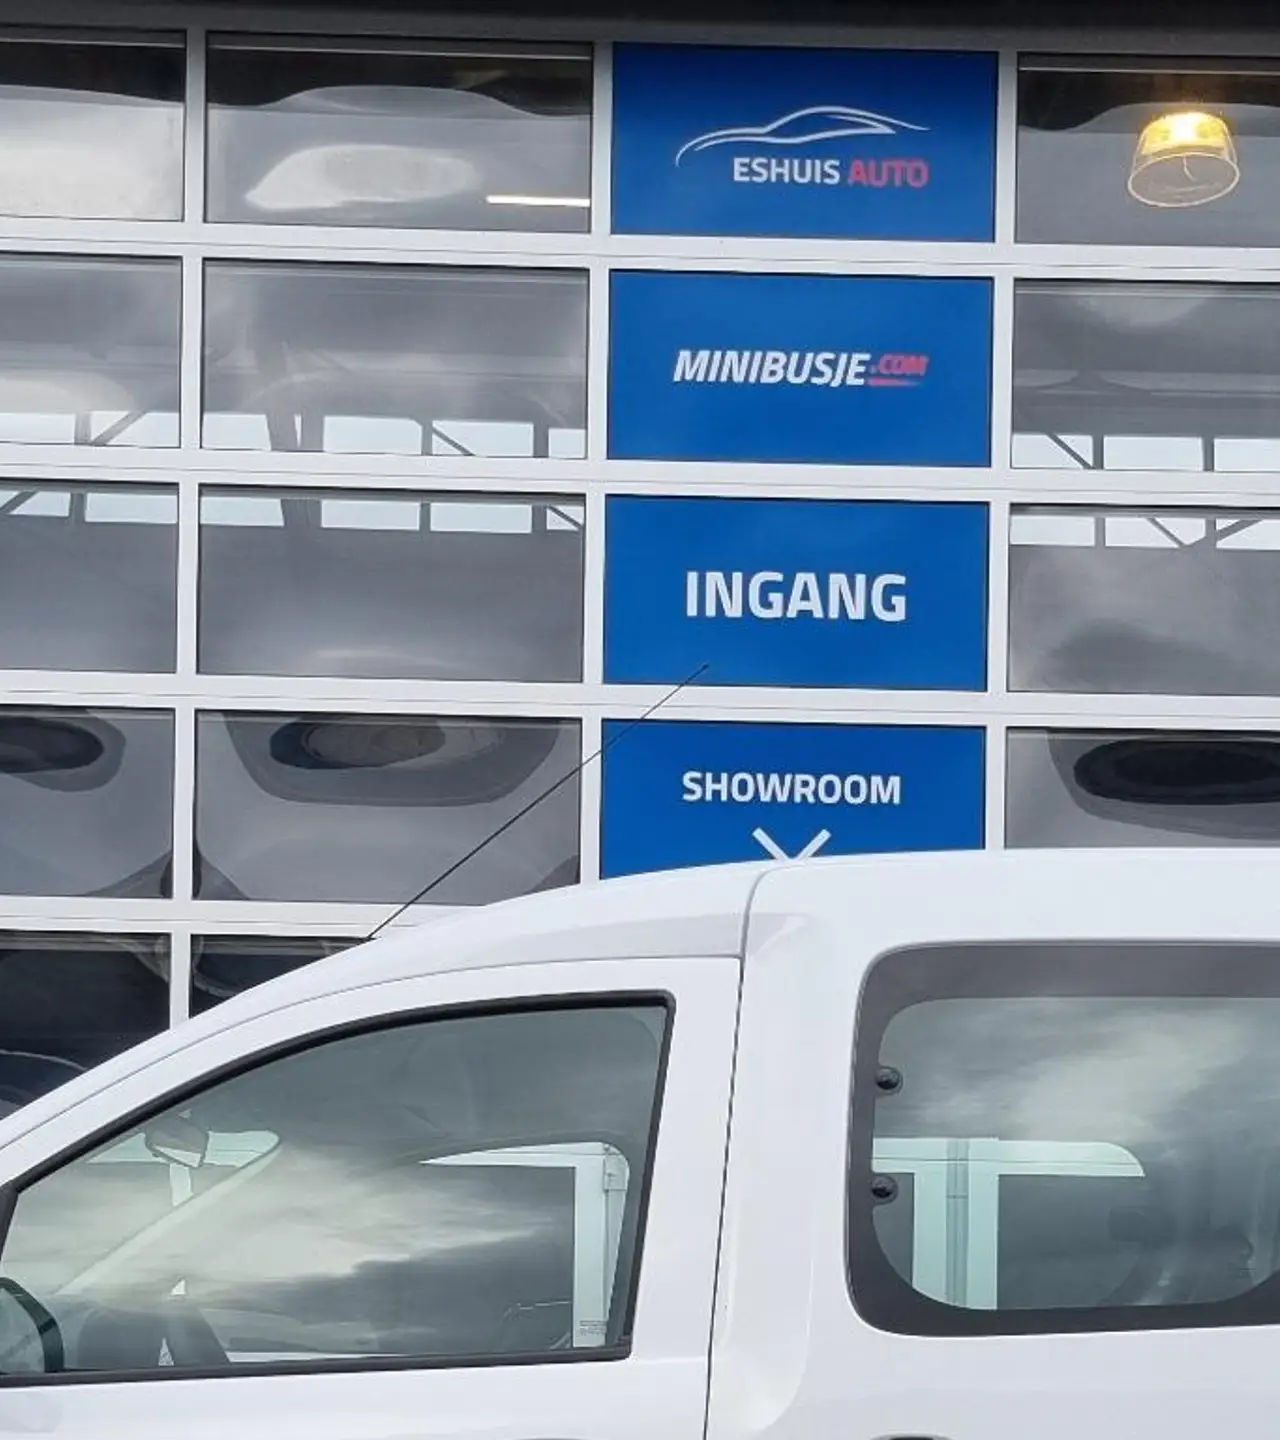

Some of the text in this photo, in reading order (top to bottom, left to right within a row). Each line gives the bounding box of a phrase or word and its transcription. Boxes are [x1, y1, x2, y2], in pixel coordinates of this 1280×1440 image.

[732, 156, 929, 189] ESHUIS AUTO
[673, 348, 929, 388] MINIBUSJE.COM
[685, 570, 908, 623] INGANG
[680, 770, 902, 806] SHOWROOM
